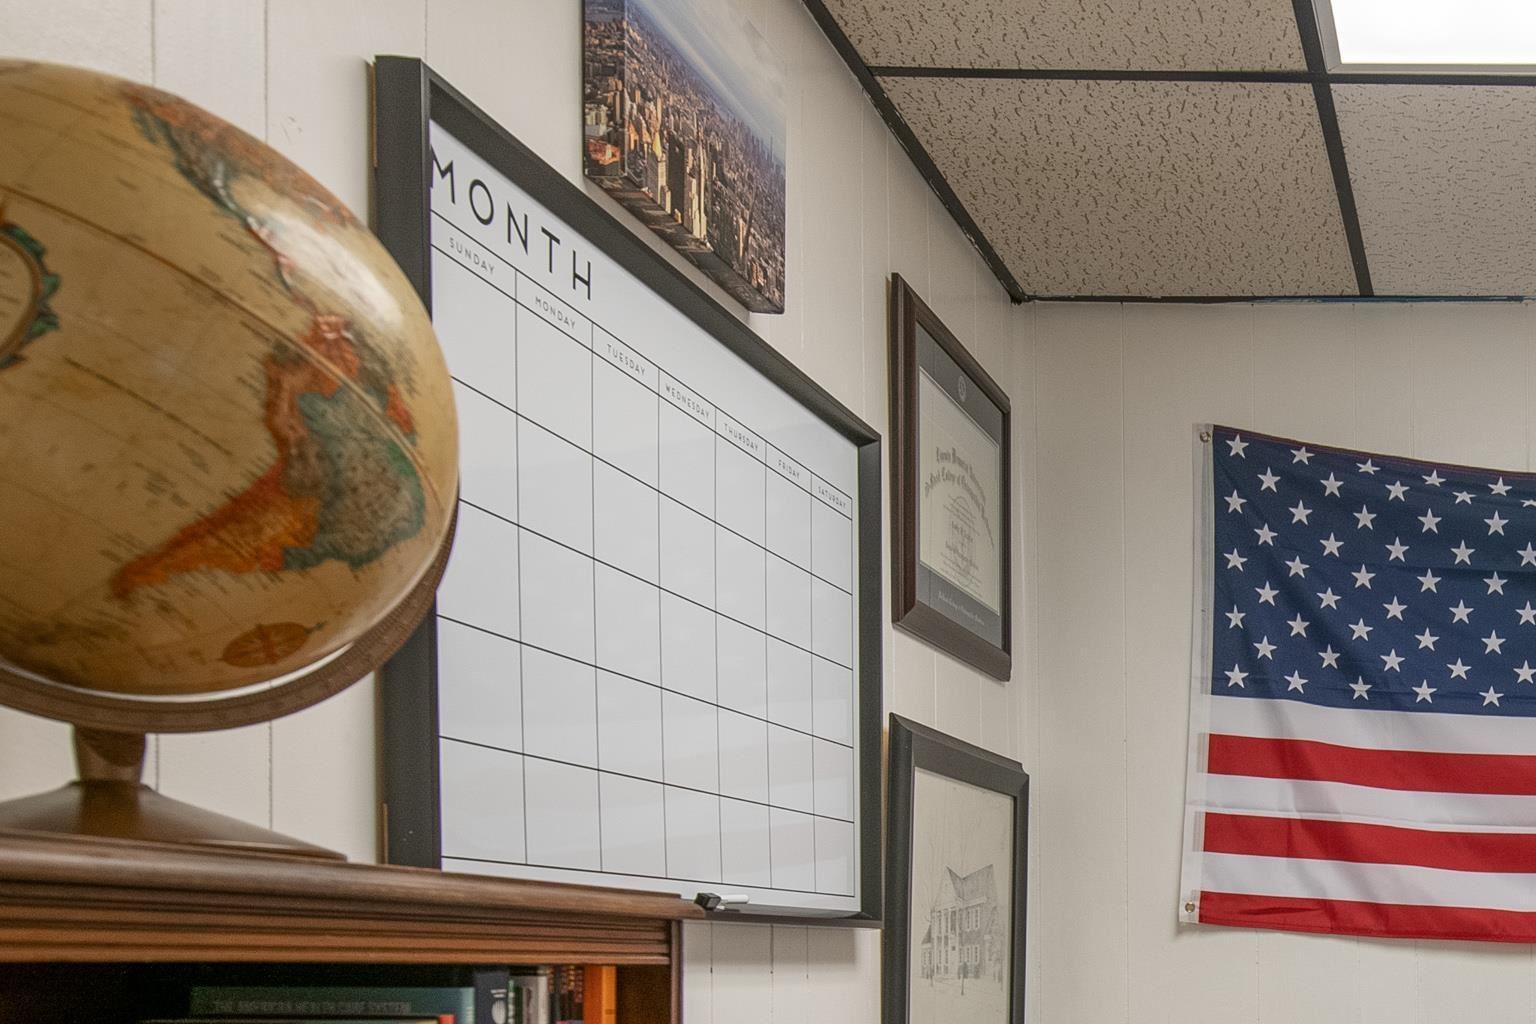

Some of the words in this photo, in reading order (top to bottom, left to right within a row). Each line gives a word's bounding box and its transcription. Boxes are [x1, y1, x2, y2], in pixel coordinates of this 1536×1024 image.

[431, 145, 592, 301] MONTH
[449, 236, 495, 275] SUNDAY
[535, 296, 576, 329] MONDAY
[607, 343, 646, 377] TUESDAY
[665, 382, 710, 420] WEDNESDAY
[724, 422, 759, 452] THURSDAY
[778, 459, 801, 480] FRIDAY
[818, 486, 847, 509] SATURDAY
